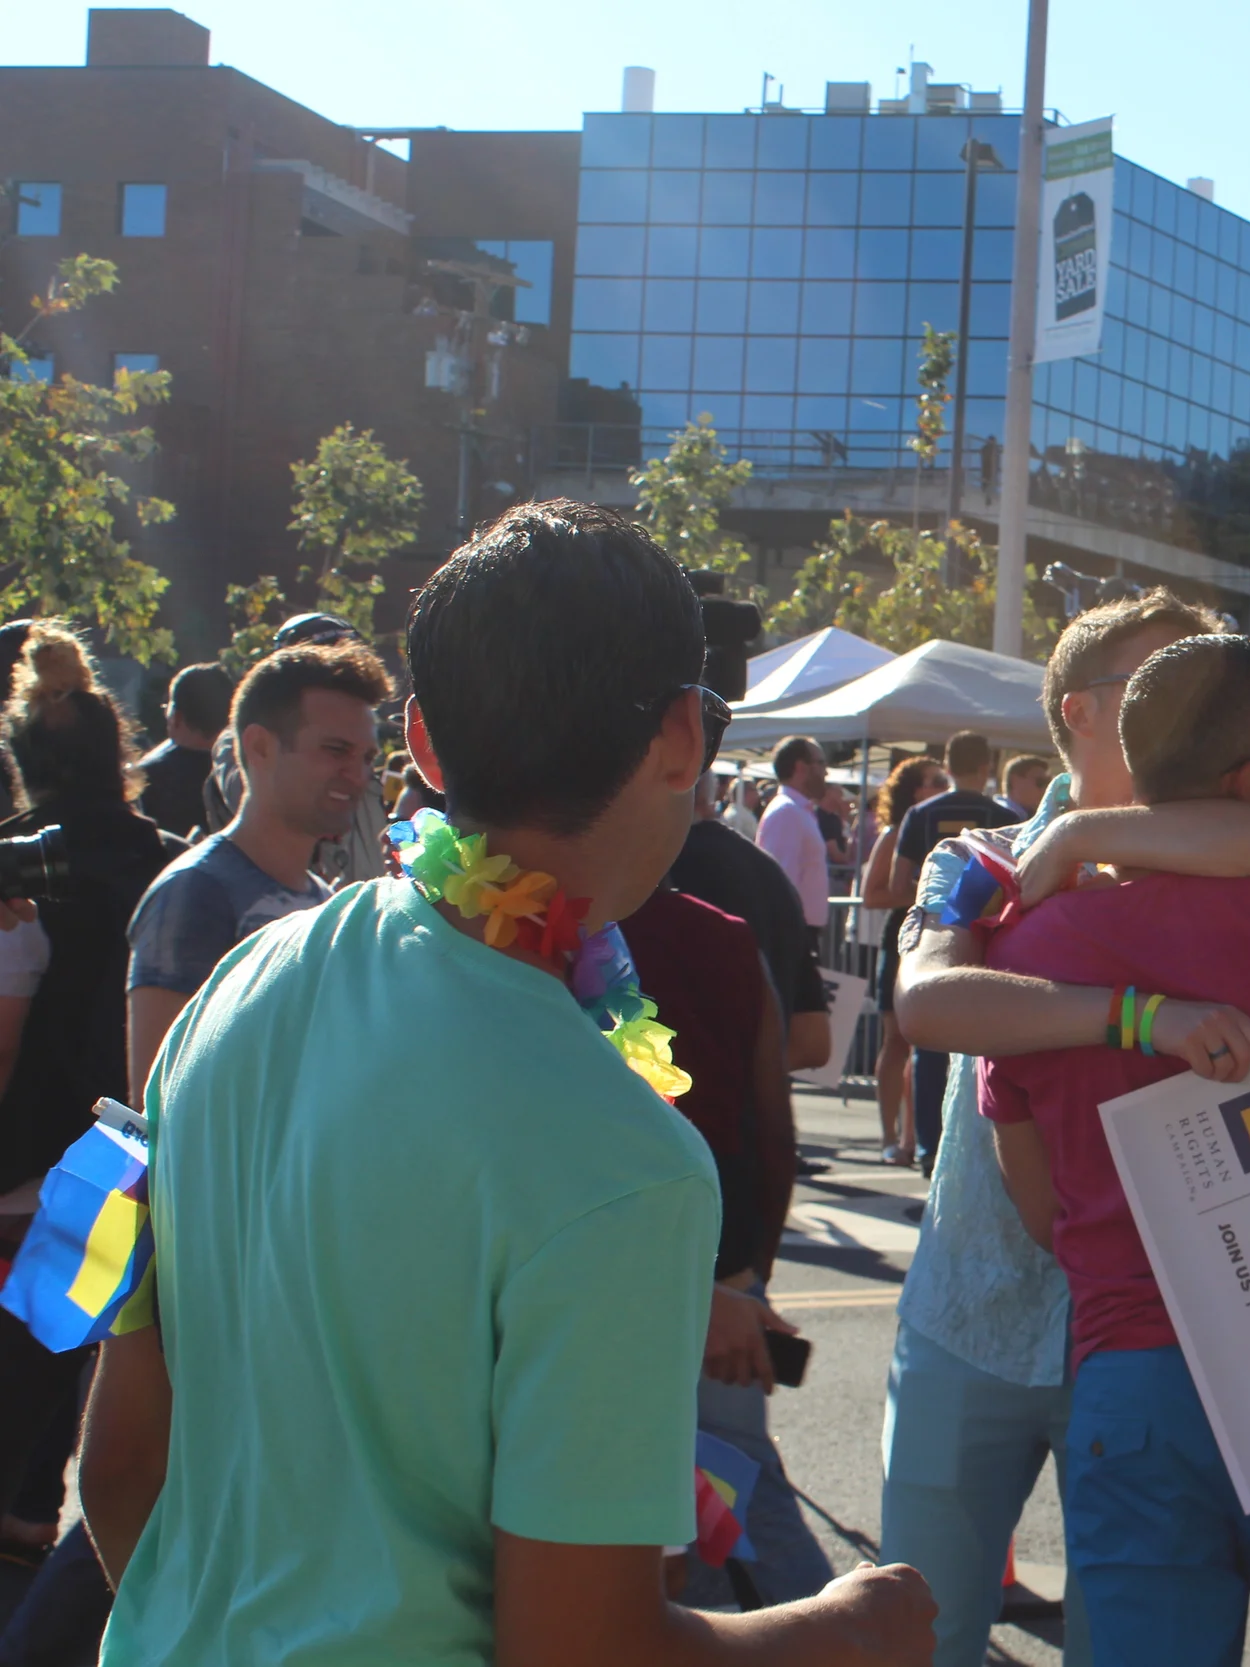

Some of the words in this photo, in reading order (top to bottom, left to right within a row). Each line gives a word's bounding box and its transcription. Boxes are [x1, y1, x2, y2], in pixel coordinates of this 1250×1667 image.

[1057, 249, 1095, 280] YARD
[1056, 269, 1096, 304] SALE
[1179, 1117, 1215, 1189] RIGHTS
[1196, 1110, 1232, 1182] HUMAN
[1218, 1223, 1244, 1264] JOIN
